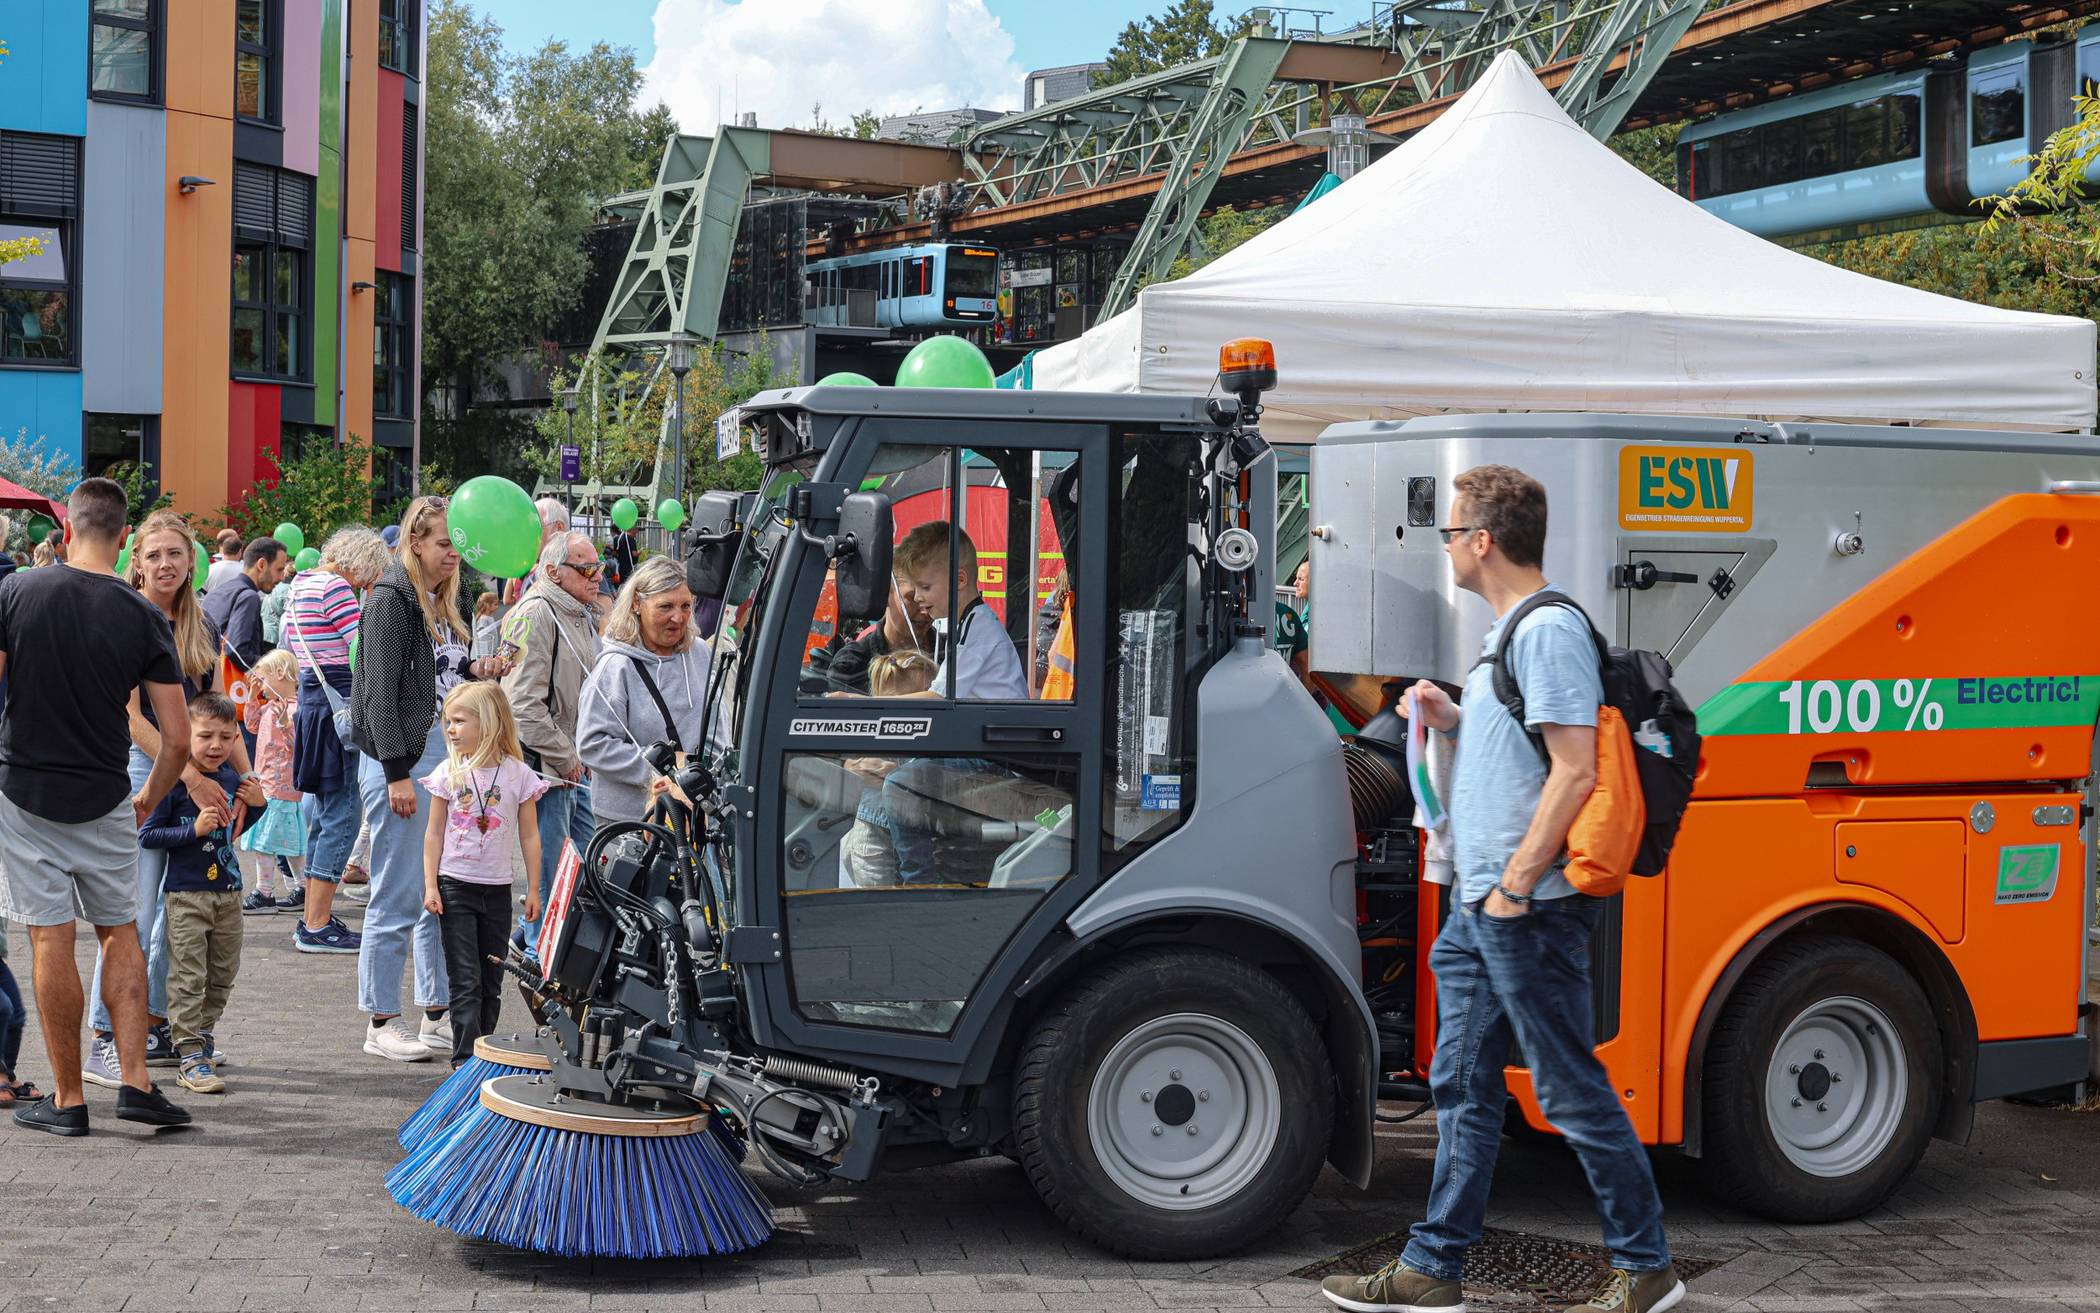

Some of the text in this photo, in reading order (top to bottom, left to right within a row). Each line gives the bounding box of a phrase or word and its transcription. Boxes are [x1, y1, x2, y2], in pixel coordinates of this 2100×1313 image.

[981, 300, 993, 310] 16
[1638, 456, 1739, 509] ESW
[1779, 676, 2080, 734] 100 % Electric!
[794, 722, 878, 733] CITYMASTER
